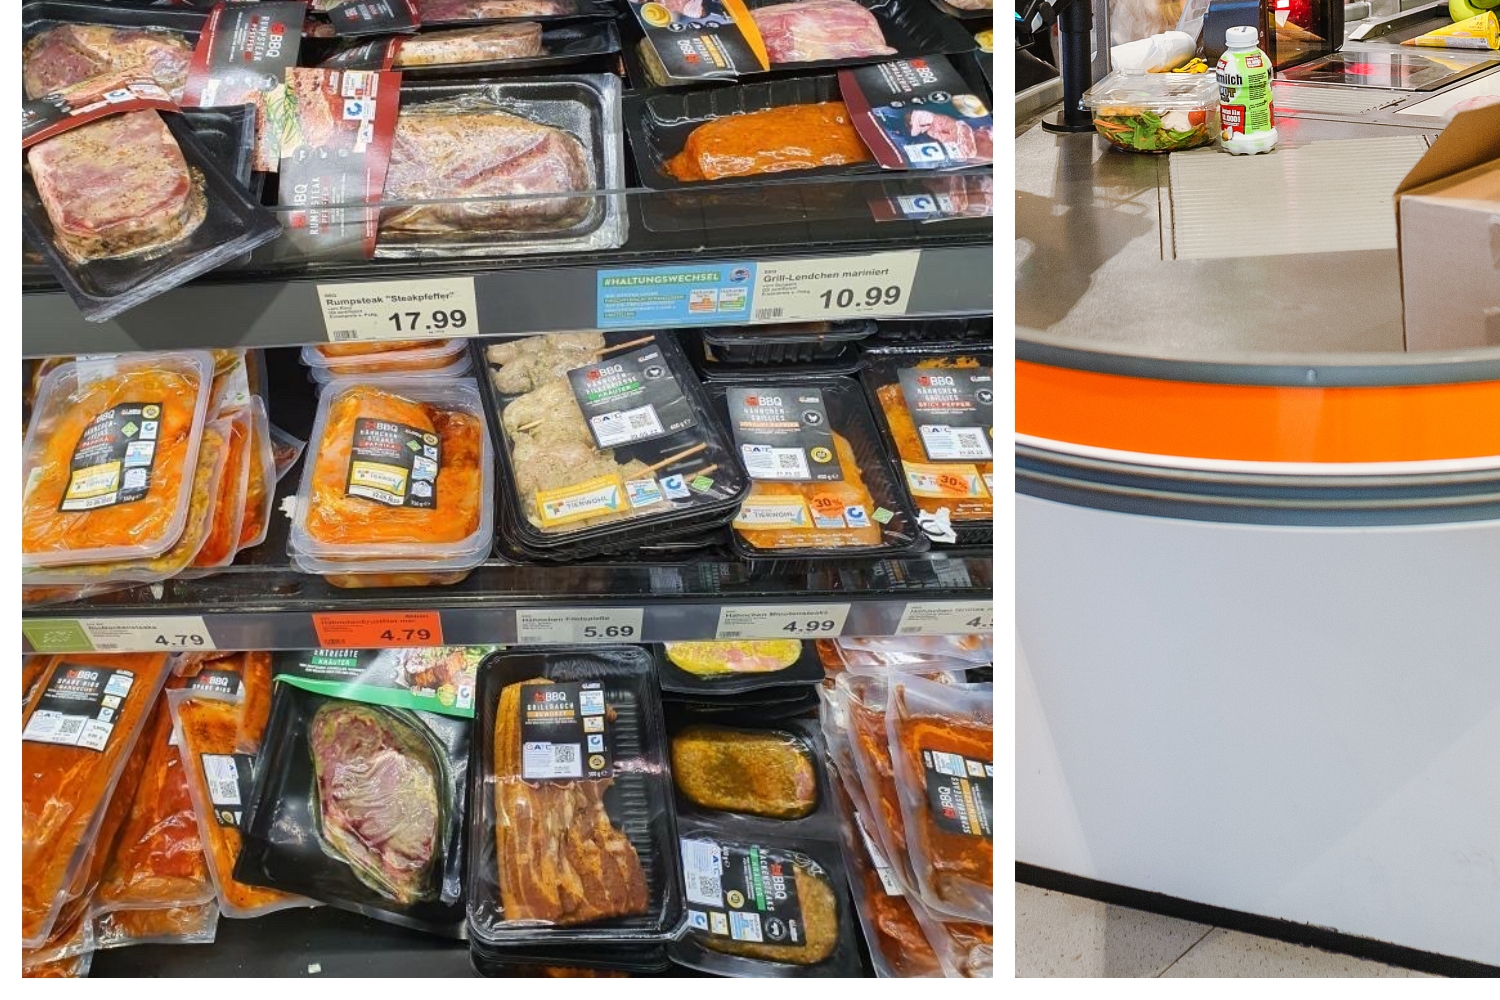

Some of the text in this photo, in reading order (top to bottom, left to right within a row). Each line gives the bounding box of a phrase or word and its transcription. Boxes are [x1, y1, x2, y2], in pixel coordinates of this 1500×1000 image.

[267, 32, 282, 58] BBQ
[604, 272, 720, 287] #HALTUNGSWECHSEL
[763, 268, 890, 284] Grill-Lendchen mariniert
[326, 291, 455, 307] Rumpsteak "Steakpfeffer"
[819, 285, 901, 310] 10.99
[388, 309, 467, 332] 17.99
[599, 364, 623, 377] BBQ
[930, 376, 955, 387] BBQ
[758, 396, 783, 407] BBQ
[376, 422, 399, 433] BBQ
[584, 626, 635, 638] 5.69
[782, 619, 836, 633] 4.99
[155, 634, 205, 646] 4.79
[380, 628, 431, 641] 4.79
[78, 670, 99, 681] BBQ
[209, 676, 229, 687] BBQ
[545, 691, 567, 702] BBQ
[937, 785, 951, 808] BBQ
[772, 875, 787, 901] BBQ
